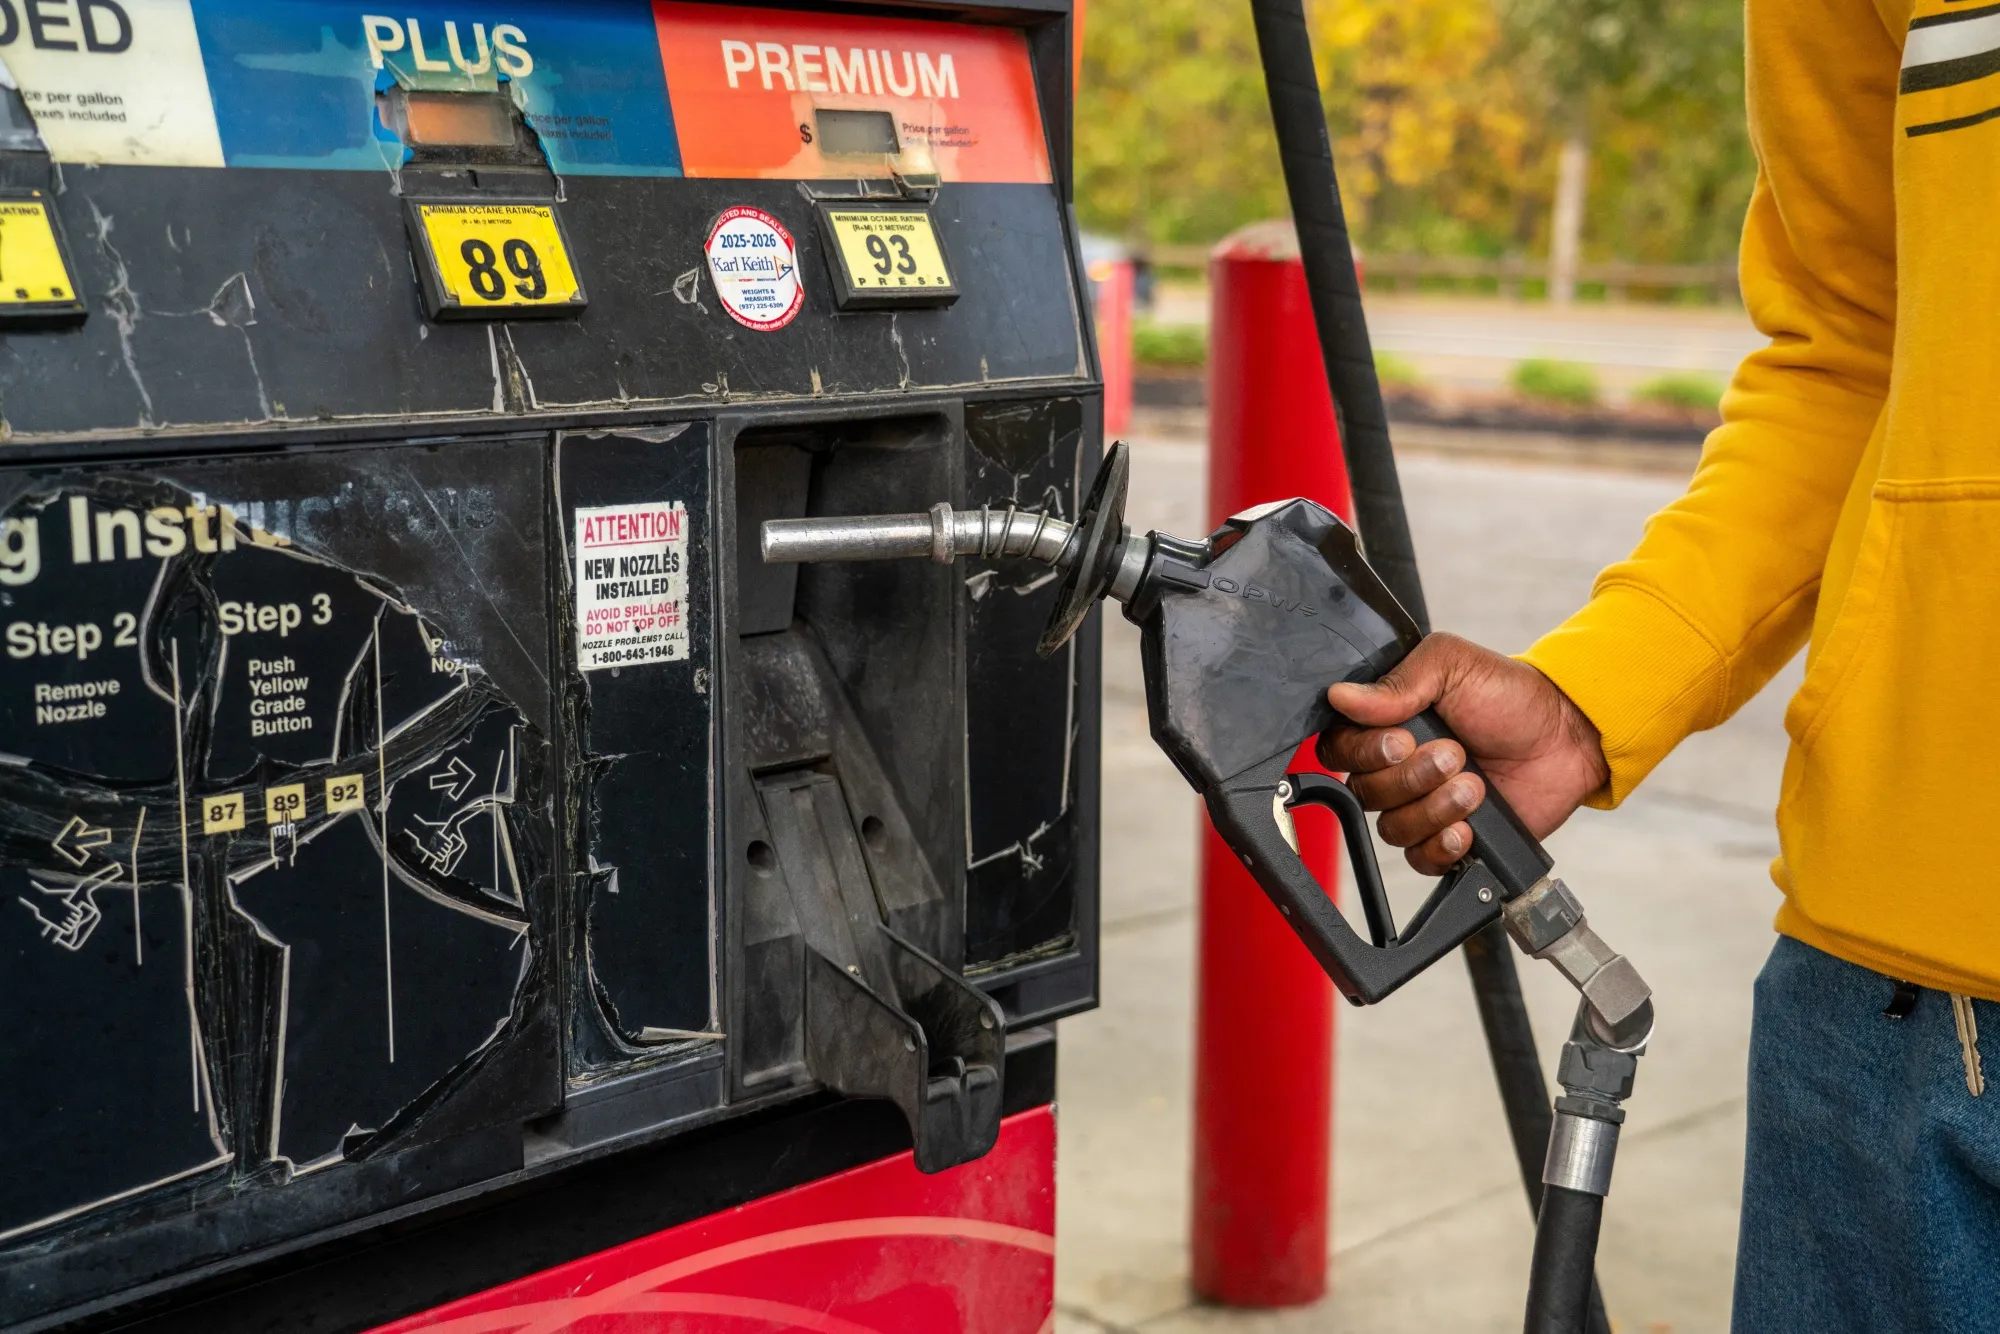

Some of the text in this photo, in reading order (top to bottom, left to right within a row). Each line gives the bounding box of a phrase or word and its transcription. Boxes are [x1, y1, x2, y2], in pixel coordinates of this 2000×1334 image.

[362, 15, 533, 78] PLUS
[721, 40, 959, 99] PREMIUM
[47, 91, 72, 104] per
[77, 91, 123, 106] gallon
[33, 109, 127, 123] axes included
[554, 114, 572, 125] per
[576, 115, 609, 127] gallon
[799, 123, 813, 144] $
[902, 122, 969, 136] Price per gallon
[429, 205, 467, 214] MINIMUM
[468, 206, 503, 215] OCTANE
[505, 206, 536, 215] RATING
[741, 208, 758, 218] AND
[759, 213, 788, 239] SEALED
[720, 233, 777, 248] 2025-2026
[712, 256, 774, 272] Karl Keith
[865, 234, 917, 275] 93
[460, 239, 548, 301] 89
[584, 552, 680, 581] NEW NOZZLES
[596, 577, 669, 600] INSTALLED
[219, 594, 333, 637] Step 3
[586, 601, 680, 622] AVOID SPILLAGE
[586, 614, 680, 636] DO NOT TOP OFF
[6, 612, 137, 660] Step 2
[582, 632, 685, 650] NOZZLE PROBLEMS? CALL
[592, 645, 675, 664] 1-800-643-1948
[248, 656, 296, 677] Push
[35, 680, 121, 703] Remove
[249, 676, 309, 698] Yellow
[36, 700, 107, 726] Nozzle
[250, 696, 306, 718] Grade
[252, 714, 313, 738] Button
[273, 793, 300, 812] 89
[332, 784, 358, 802] 92
[210, 803, 238, 822] 87
